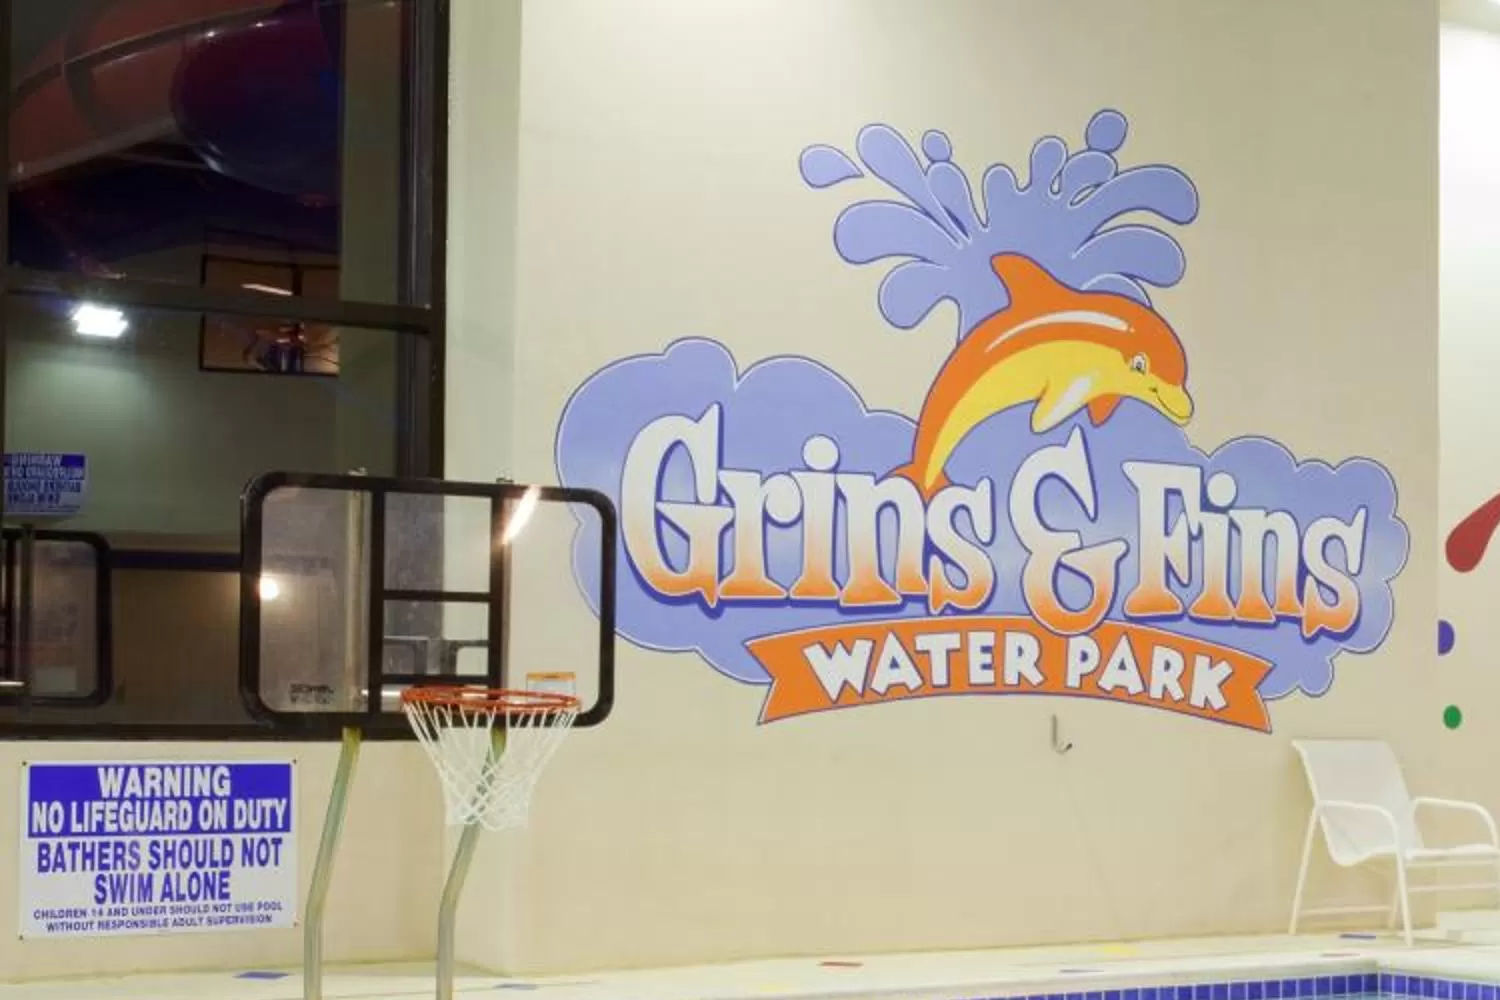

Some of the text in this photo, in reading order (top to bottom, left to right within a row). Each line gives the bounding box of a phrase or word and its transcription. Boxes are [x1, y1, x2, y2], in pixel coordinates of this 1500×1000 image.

[619, 402, 1367, 639] Grins & Fins
[801, 632, 1234, 711] WATER PARK
[98, 766, 231, 798] WARNING
[32, 798, 287, 833] NO LIFEGUARD ON DUTY
[37, 838, 282, 873] BATHERS SHOULD NOT
[94, 871, 231, 904] SWIM ALONE
[33, 908, 87, 920] CHILDREN
[108, 907, 128, 917] AND
[131, 905, 167, 917] UNDER
[170, 904, 210, 915] SHOULD
[212, 903, 232, 913] NOT
[235, 902, 254, 912] USE
[257, 901, 283, 912] POOL
[47, 914, 272, 932] WITHOUT RESPONSIBLE ADULT SUPERVISION
